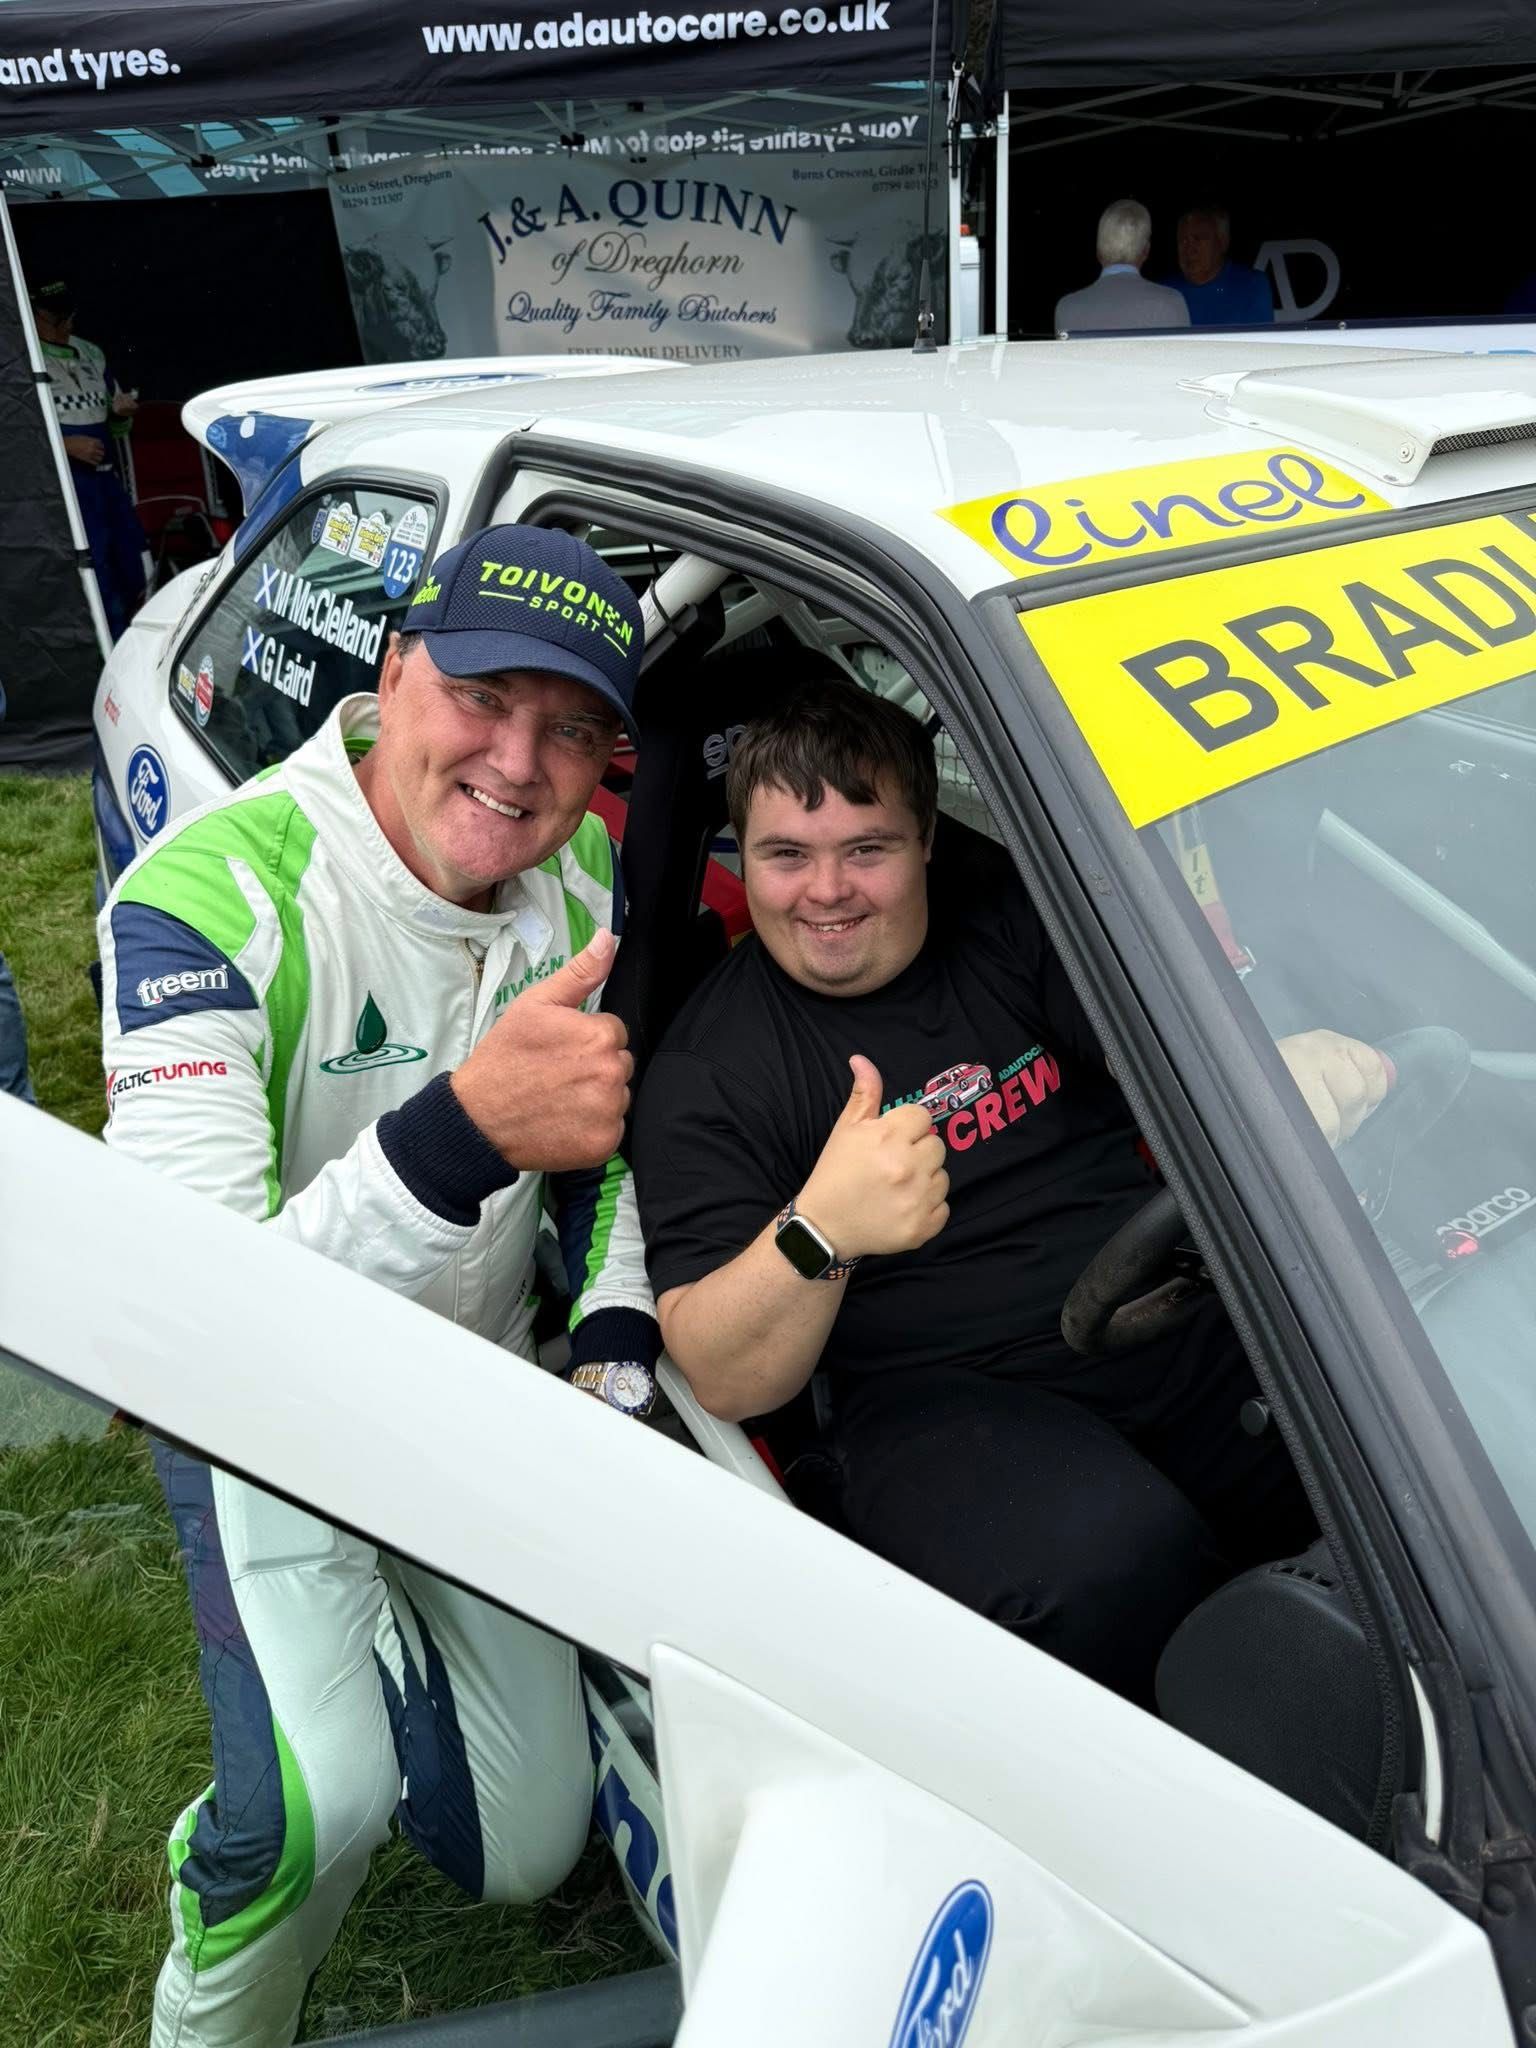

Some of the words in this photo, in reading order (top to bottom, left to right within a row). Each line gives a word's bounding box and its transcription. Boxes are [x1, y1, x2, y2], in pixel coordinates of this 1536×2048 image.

[422, 1, 891, 54] www.adautocare.co.uk
[0, 48, 67, 85] and
[69, 48, 181, 90] tyres.
[608, 179, 797, 246] QUINN
[551, 238, 588, 286] of
[585, 231, 744, 291] Dreghorn
[505, 290, 583, 334] Quality
[586, 289, 671, 333] Family
[662, 344, 744, 359] DELIVERY
[386, 547, 417, 584] 123
[273, 571, 294, 618] M
[288, 578, 387, 666] McClelland
[529, 596, 600, 632] SPORT
[261, 637, 276, 683] G
[274, 644, 317, 707] Laird
[131, 757, 163, 831] Ford
[137, 965, 229, 1006] freem
[946, 1052, 1062, 1151] CREW
